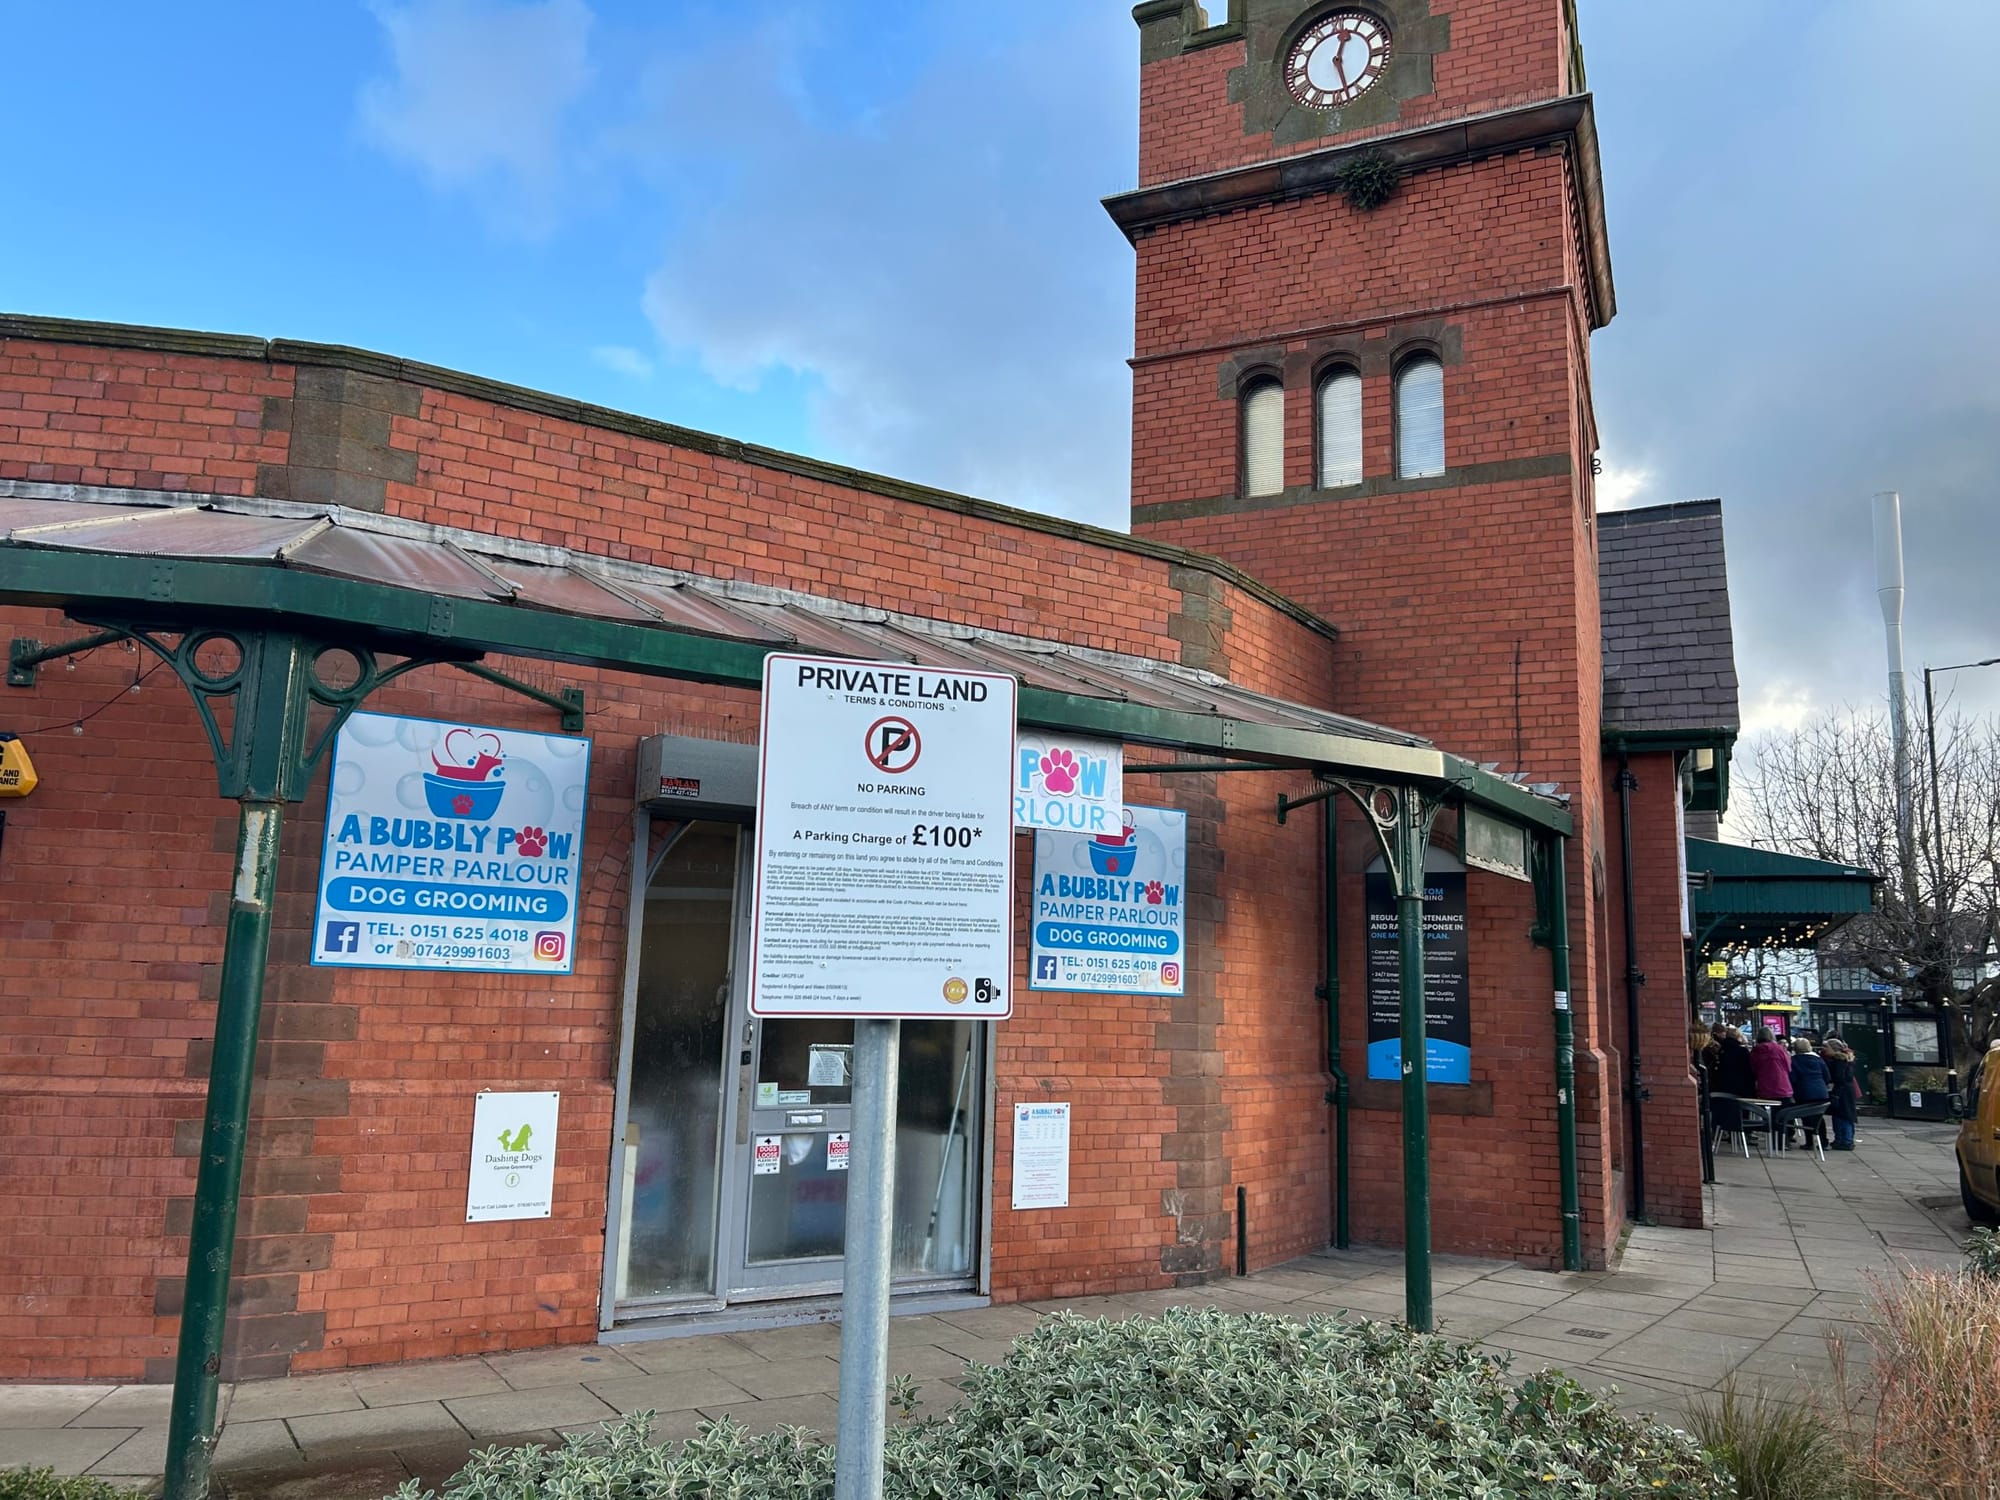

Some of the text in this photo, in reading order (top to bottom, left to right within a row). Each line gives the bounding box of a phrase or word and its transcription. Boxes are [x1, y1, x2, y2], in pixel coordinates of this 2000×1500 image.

[798, 665, 988, 703] PRIVATE LAND
[845, 695, 945, 711] TERMS & CONDITIONS
[3, 769, 20, 777] AND
[857, 783, 926, 796] NO PARKING
[790, 802, 812, 810] Breach
[820, 803, 834, 811] ANY
[857, 806, 883, 814] condition
[945, 811, 960, 819] being
[1014, 798, 1106, 831] RLOUR
[337, 814, 363, 844] A
[369, 816, 491, 853] BUBBLY
[793, 830, 802, 840] A
[805, 830, 849, 844] Parking
[852, 832, 892, 846] Charge
[895, 835, 907, 845] of
[768, 849, 776, 858] By
[777, 850, 800, 859] entering
[808, 852, 836, 861] remaining
[919, 857, 925, 865] by
[976, 859, 1003, 867] Conditions
[335, 851, 569, 885] PAMPER PARLOUR
[1040, 874, 1055, 897] A
[1058, 874, 1130, 902] BUBBLY
[350, 885, 548, 914] DOG GROOMING
[1040, 901, 1178, 926] PAMPER PARLOUR
[366, 922, 529, 942] TEL: 0151 625 4018
[1050, 928, 1168, 948] DOG GROOMING
[375, 943, 511, 960] or 07429991603
[1061, 956, 1157, 970] TEL: 0151 625 4018
[1066, 972, 1078, 981] or
[485, 1153, 543, 1164] Dashing Dogs
